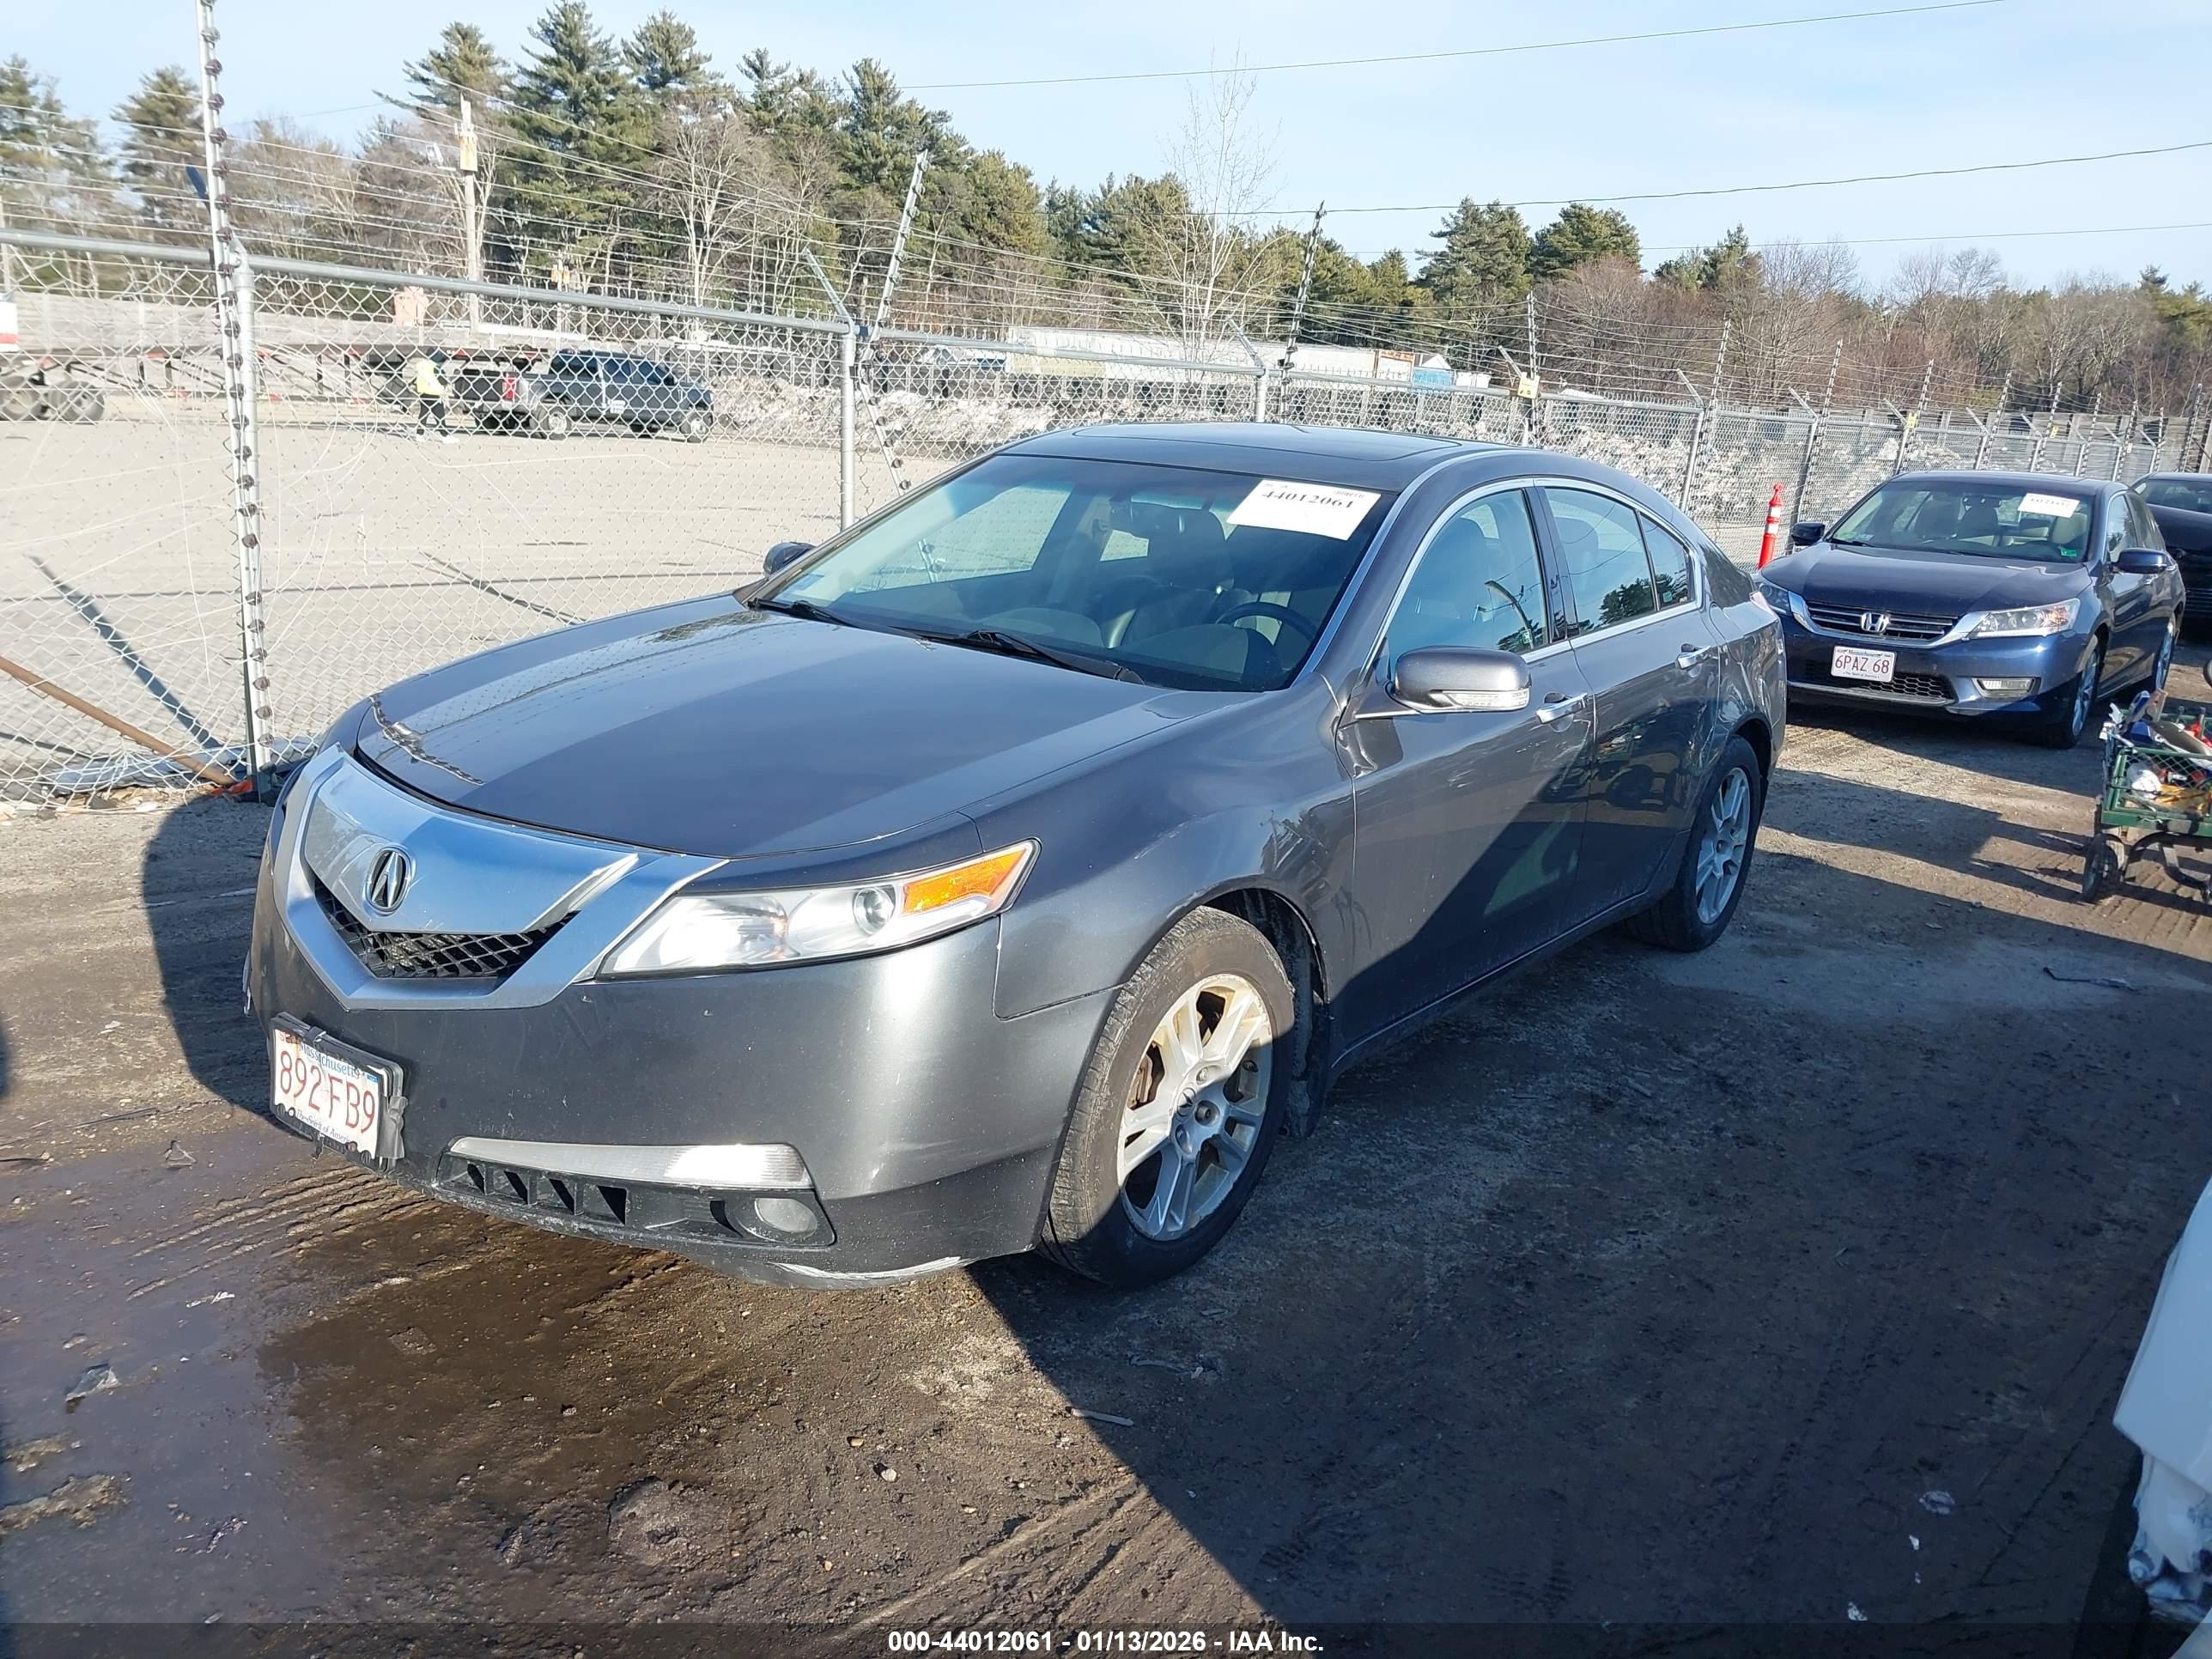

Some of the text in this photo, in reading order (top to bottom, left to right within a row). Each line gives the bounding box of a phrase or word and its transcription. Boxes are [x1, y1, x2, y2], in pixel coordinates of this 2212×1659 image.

[1261, 490, 1355, 508] 44012061
[1834, 654, 1890, 674] 6PAZ 68
